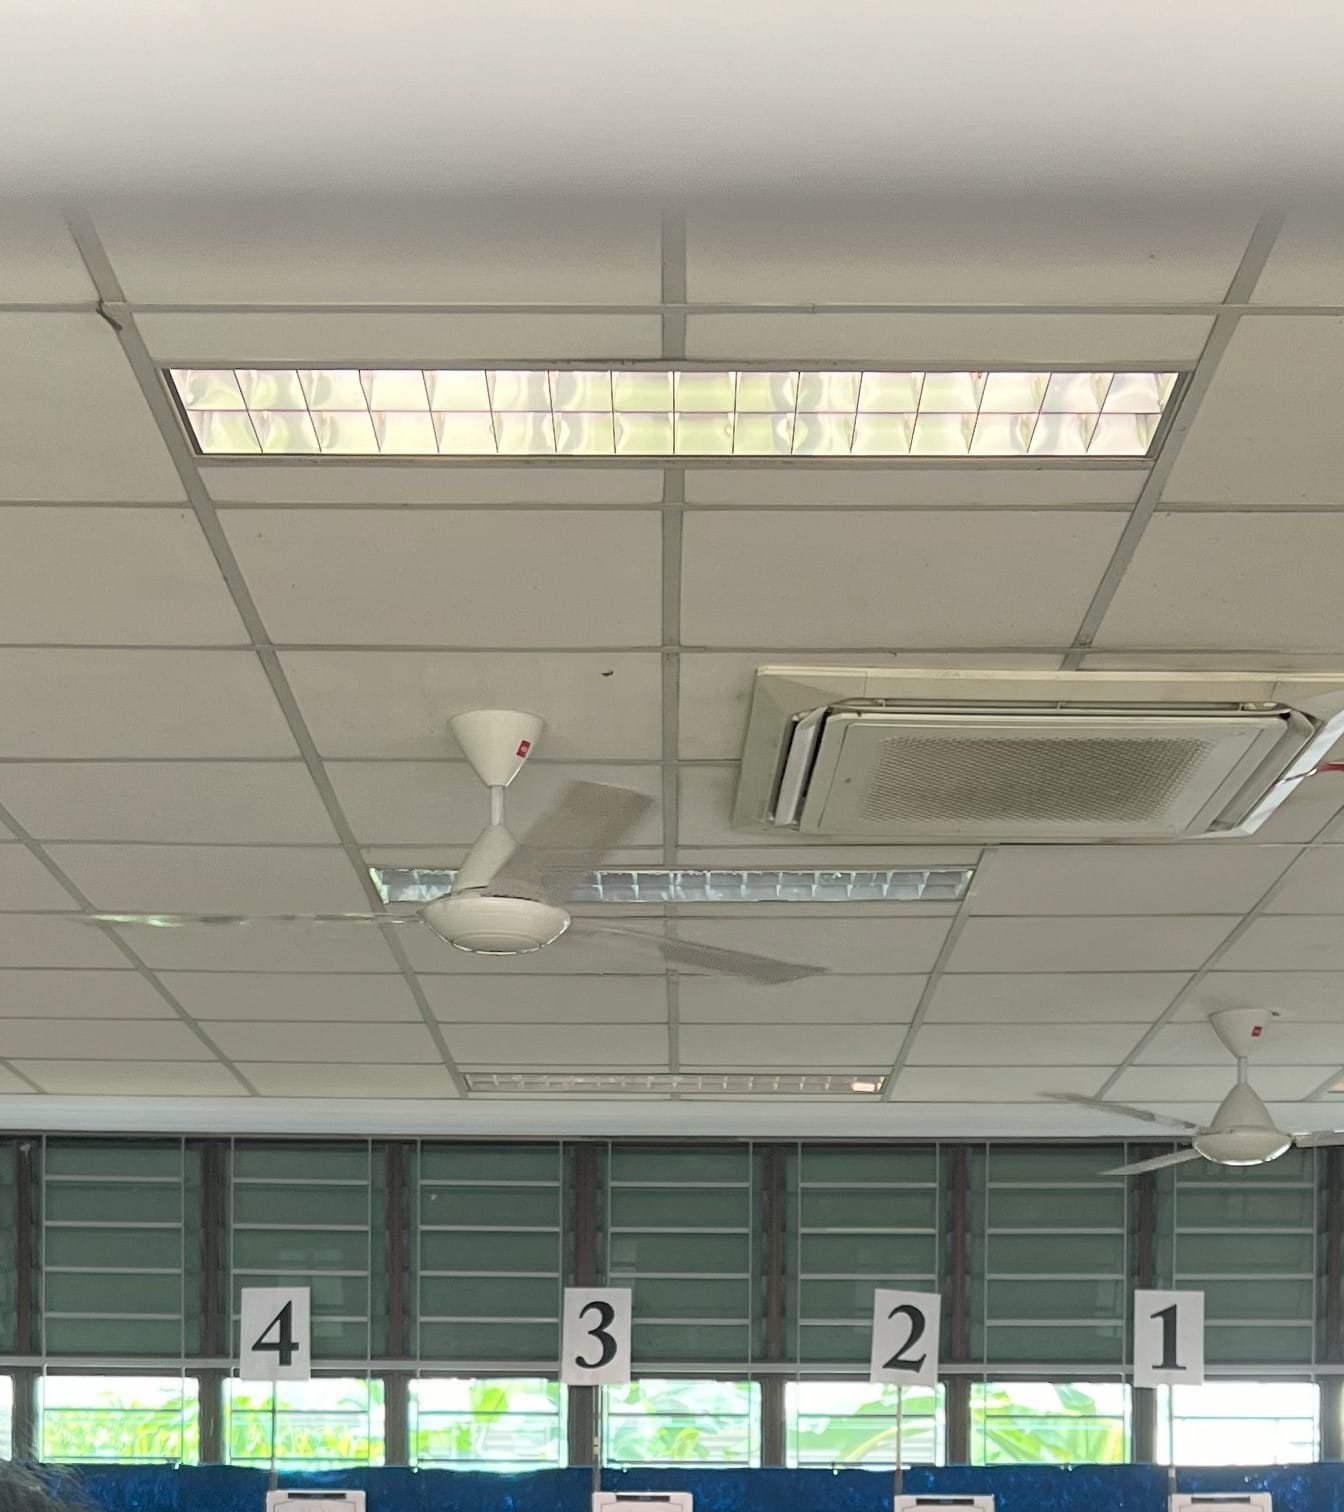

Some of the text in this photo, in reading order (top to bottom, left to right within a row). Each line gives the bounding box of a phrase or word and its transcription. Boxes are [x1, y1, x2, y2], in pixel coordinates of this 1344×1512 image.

[251, 1300, 300, 1367] 4
[575, 1300, 617, 1369] 3
[882, 1303, 927, 1373] 2
[1150, 1303, 1187, 1371] 1
